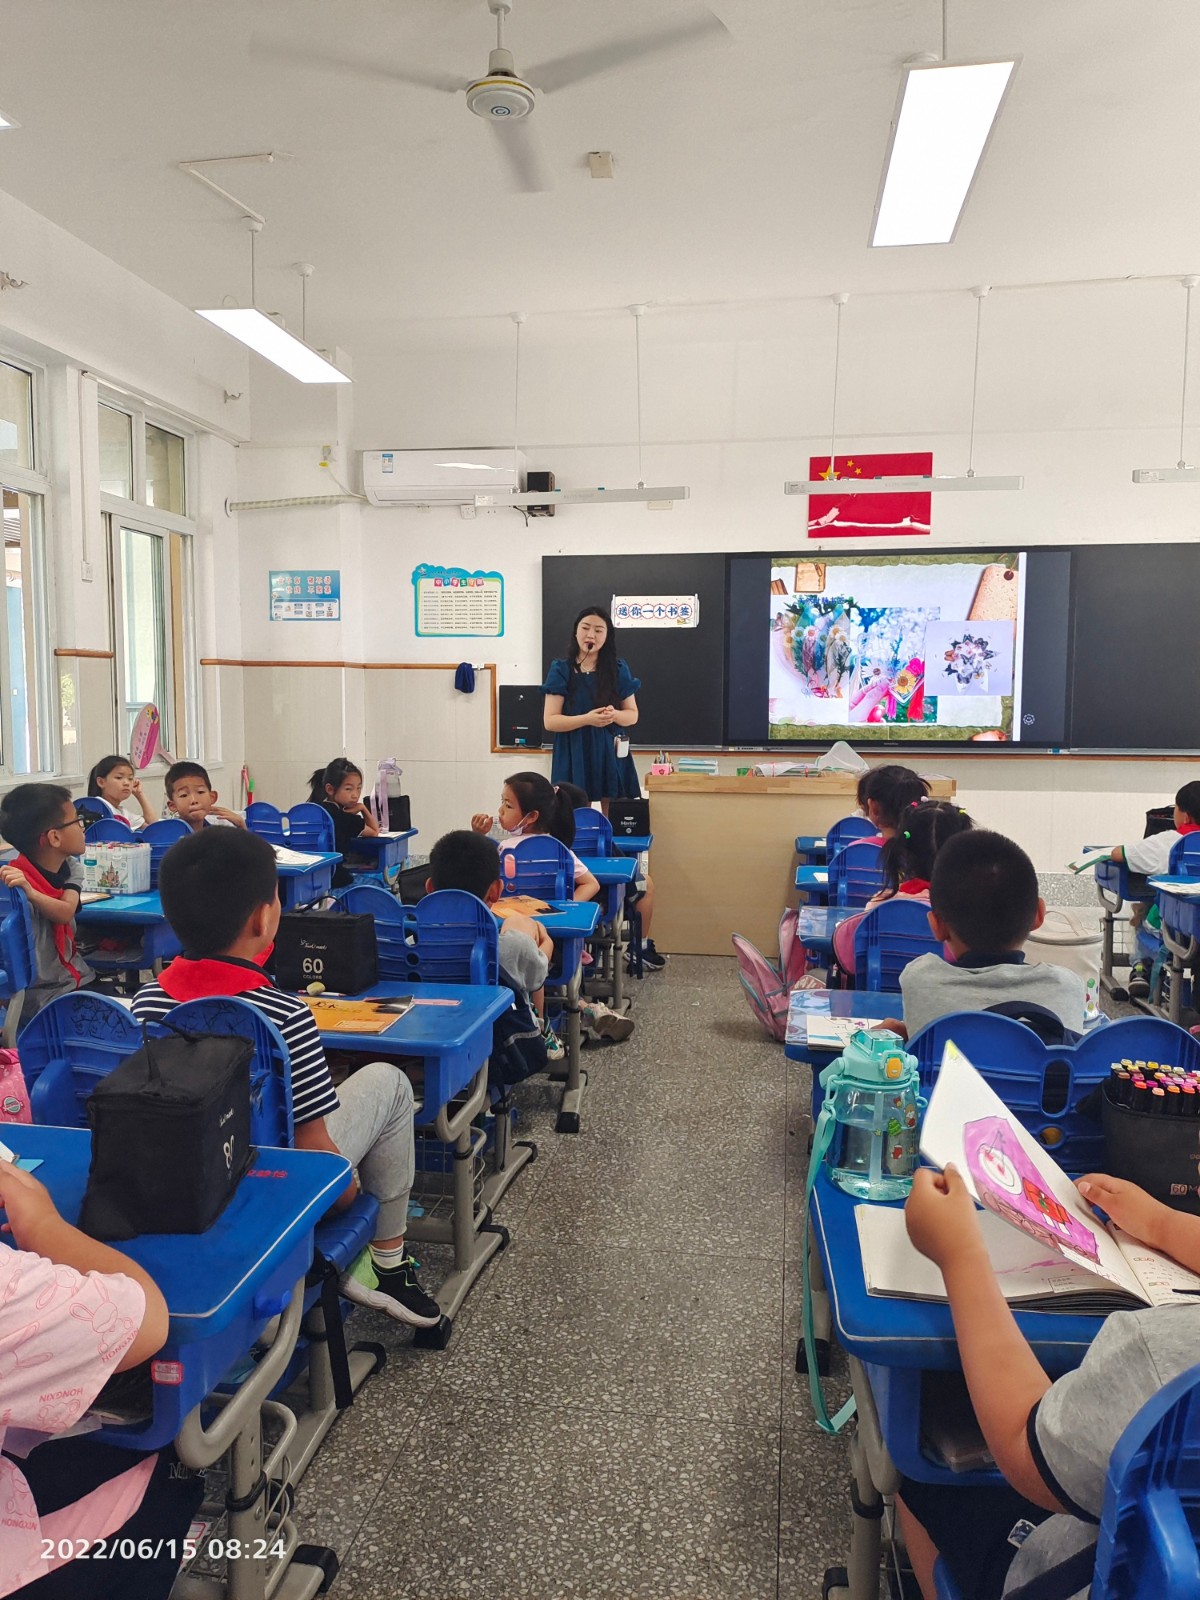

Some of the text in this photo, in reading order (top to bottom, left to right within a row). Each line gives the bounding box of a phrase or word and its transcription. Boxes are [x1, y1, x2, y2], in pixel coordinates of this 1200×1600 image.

[618, 605, 690, 617] 送你一个书签
[303, 958, 324, 974] 60
[1172, 1184, 1187, 1194] 60
[39, 1388, 84, 1403] HONGXIN
[2, 1518, 38, 1531] HONGXIN
